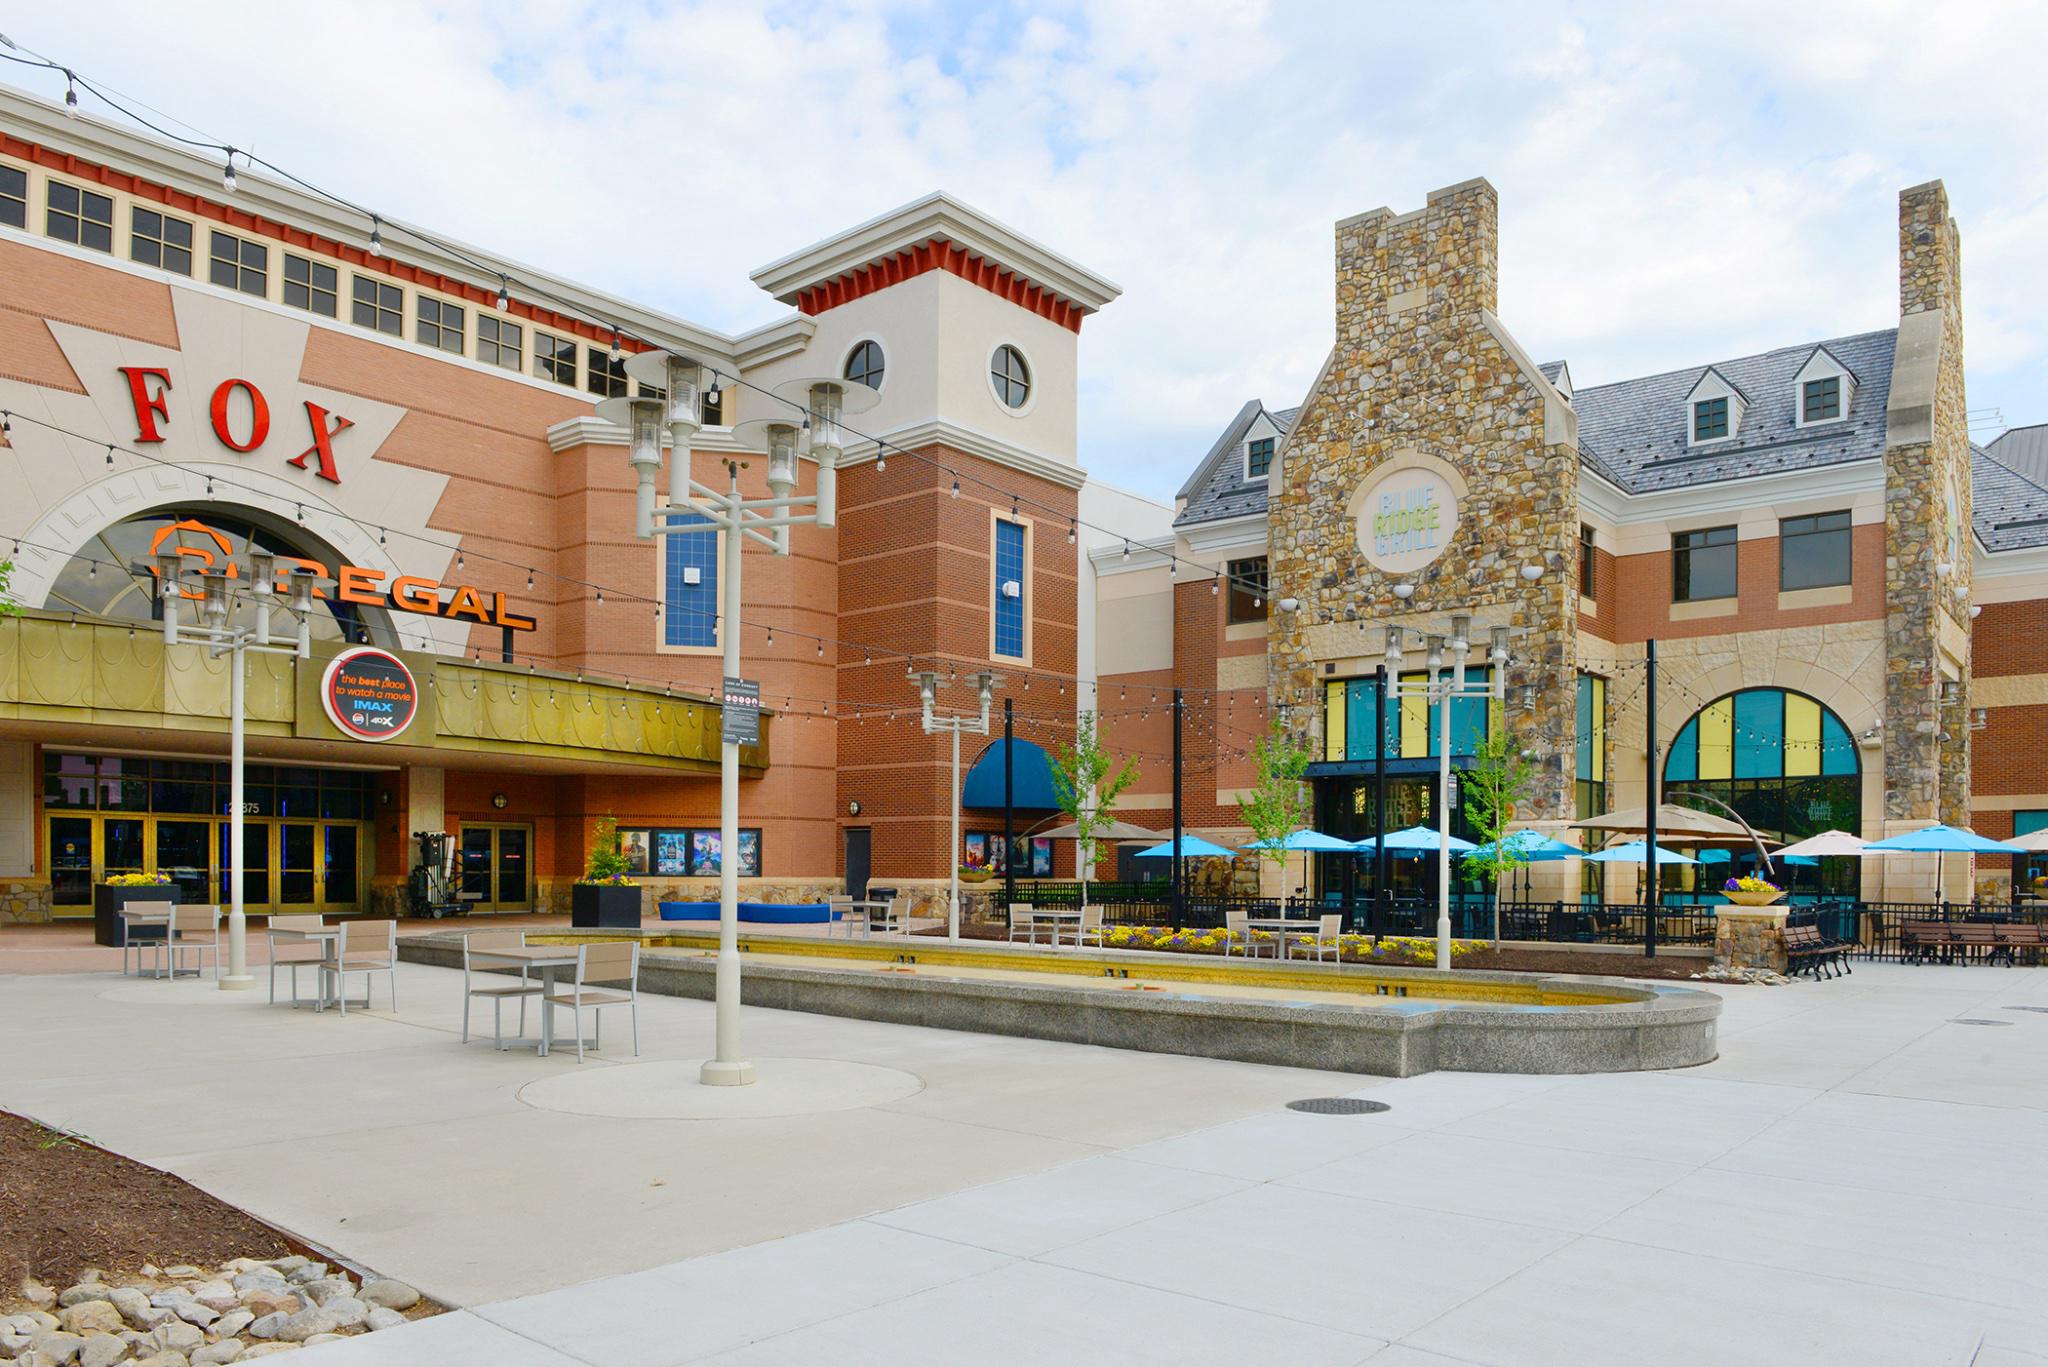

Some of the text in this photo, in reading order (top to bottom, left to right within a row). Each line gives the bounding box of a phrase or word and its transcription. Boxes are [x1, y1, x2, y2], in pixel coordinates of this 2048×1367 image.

[117, 366, 356, 485] FOX
[1378, 484, 1434, 517] BLUE
[1373, 504, 1440, 538] RIDGE
[1376, 528, 1438, 556] GRILL
[342, 674, 406, 689] the best place
[348, 688, 375, 697] watch
[385, 693, 411, 701] movie
[354, 700, 393, 712] IMAX
[229, 803, 260, 813] 2875
